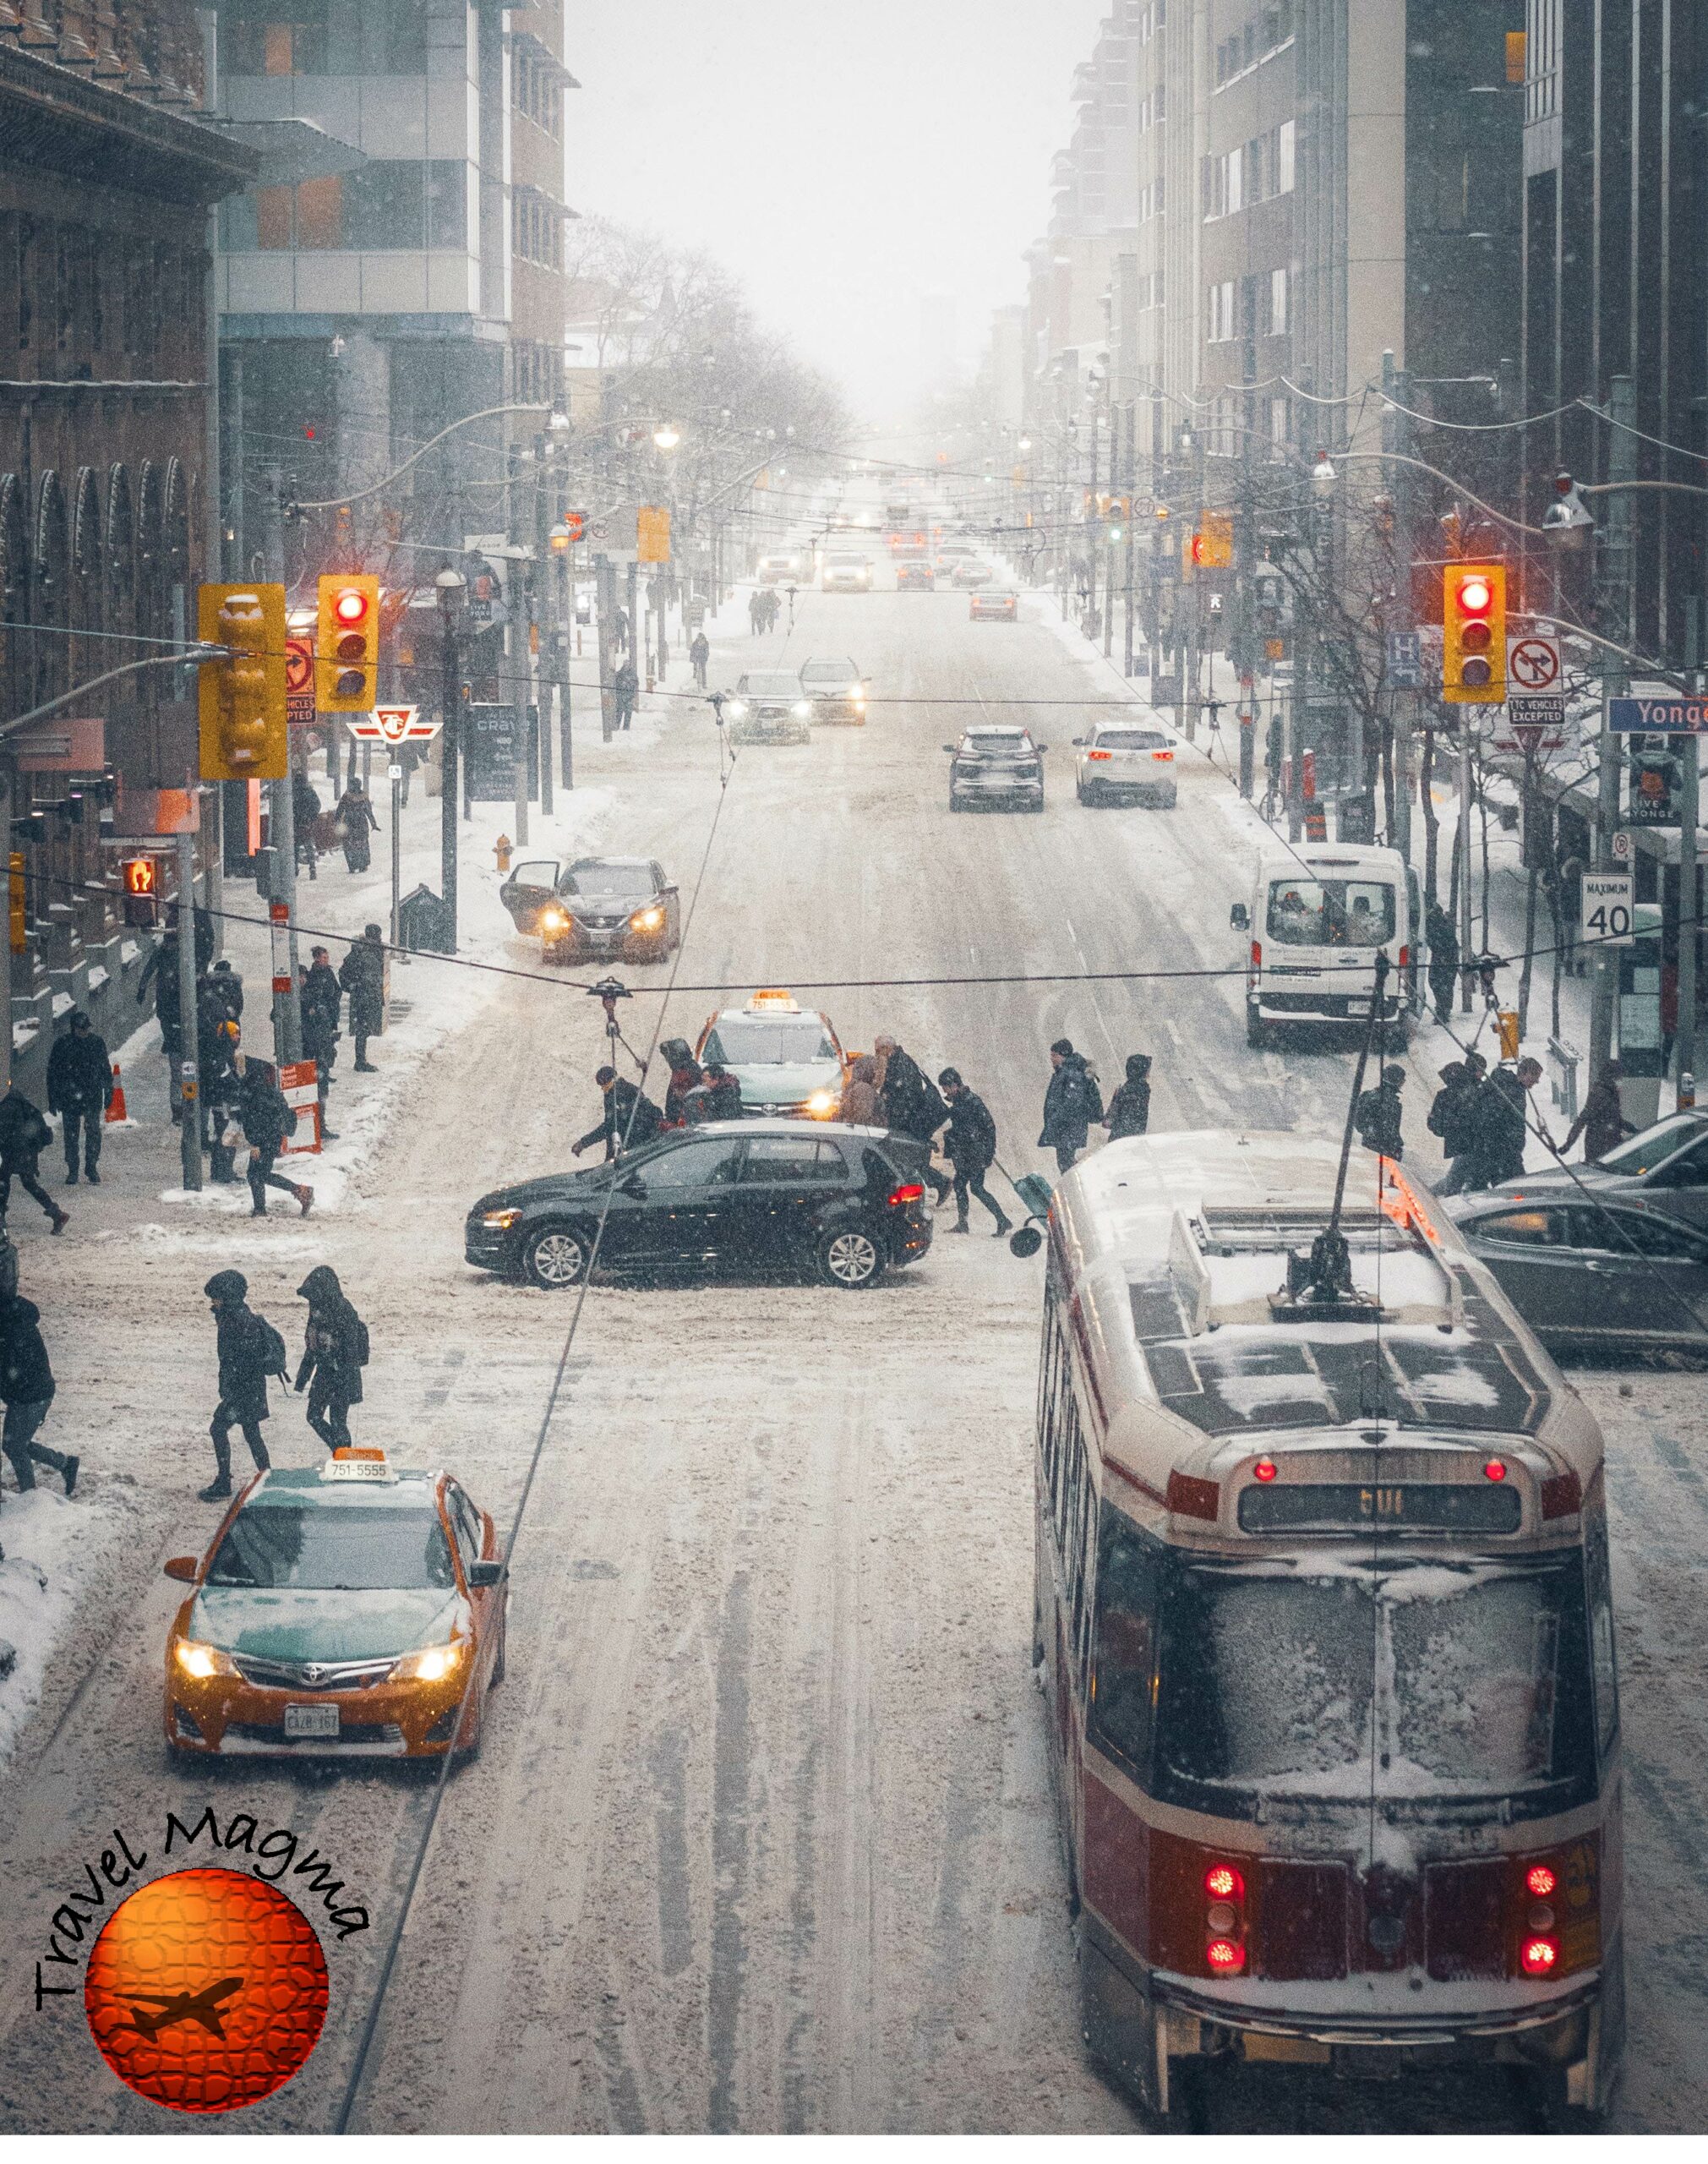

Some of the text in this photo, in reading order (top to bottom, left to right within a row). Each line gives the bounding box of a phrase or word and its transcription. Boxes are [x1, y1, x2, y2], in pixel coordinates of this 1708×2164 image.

[1527, 700, 1563, 710] VEHICLES
[1513, 712, 1562, 721] EXCEPTED
[1631, 810, 1674, 818] YONGE
[1587, 883, 1629, 893] MAXIMUM
[1587, 905, 1629, 936] 40
[331, 1464, 387, 1477] 751-5555
